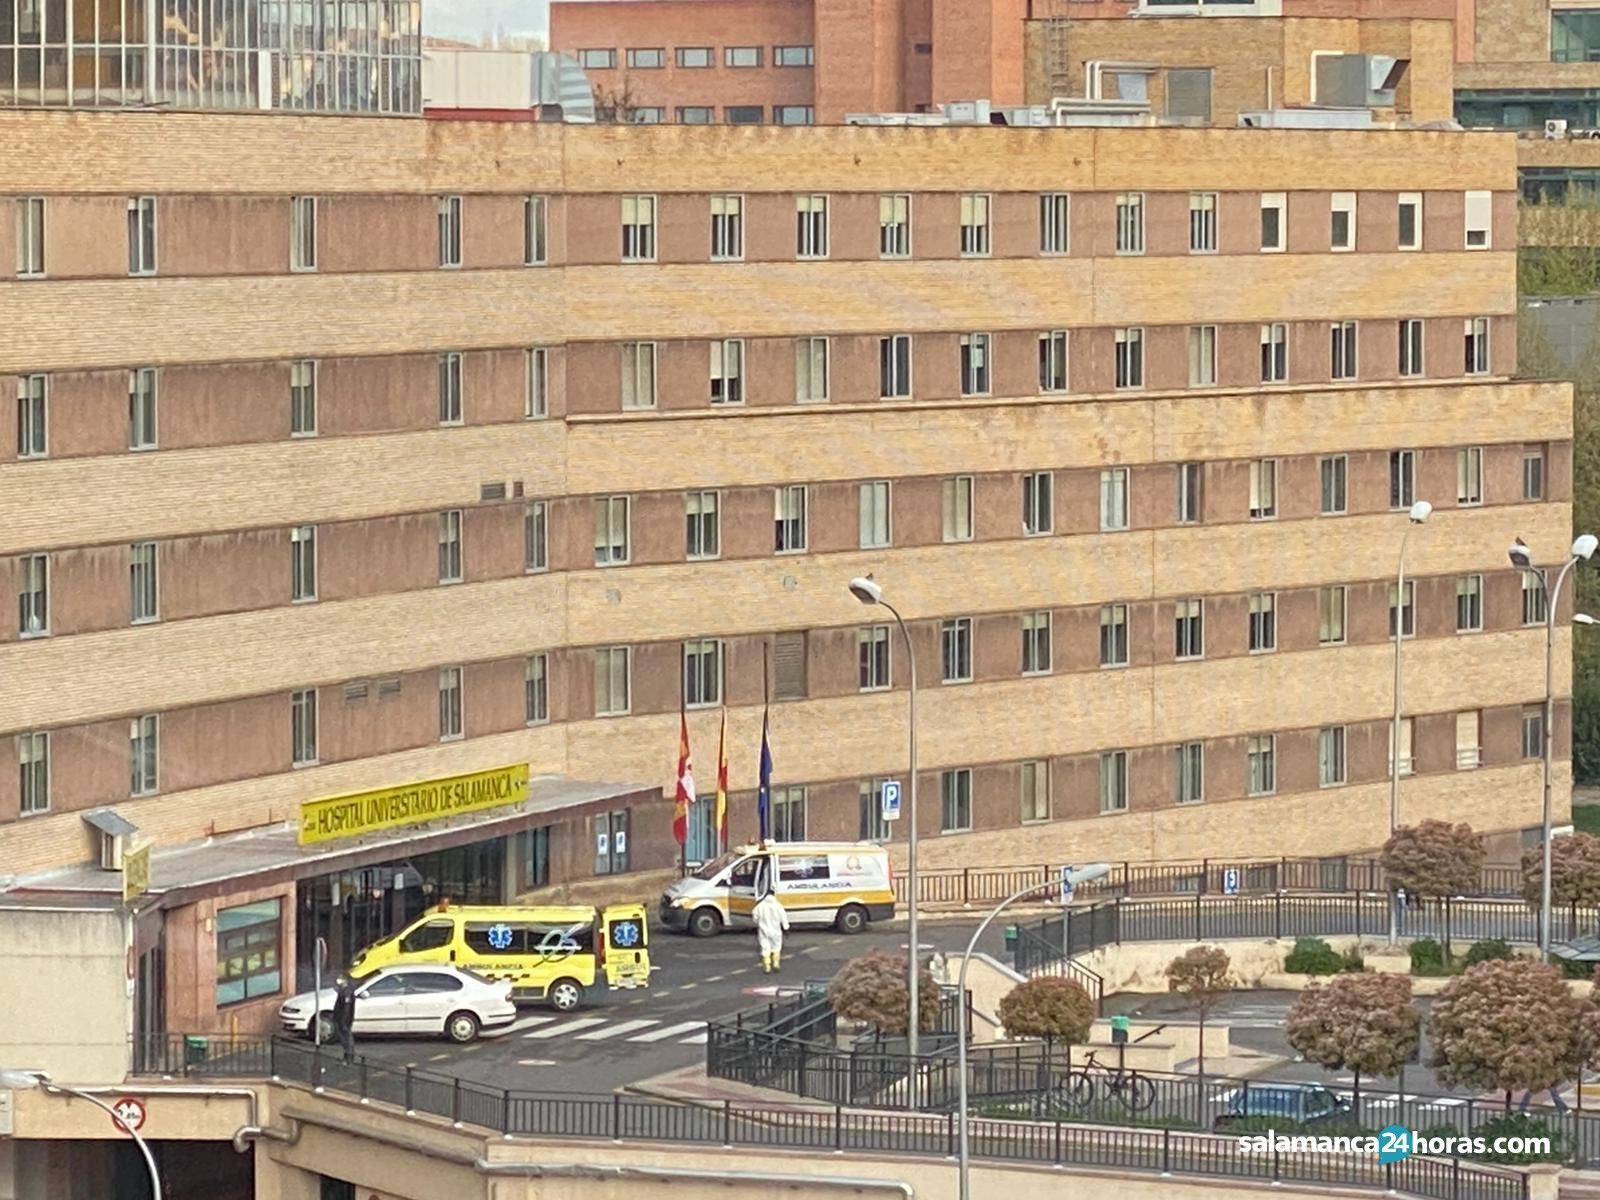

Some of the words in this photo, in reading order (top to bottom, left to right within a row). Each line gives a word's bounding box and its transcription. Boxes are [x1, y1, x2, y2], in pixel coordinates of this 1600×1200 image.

[317, 802, 365, 834] HOSPITAL
[366, 787, 438, 824] UNIVERSITARIO
[440, 784, 453, 811] DE
[454, 774, 512, 807] SALAMANCA
[886, 785, 897, 809] P
